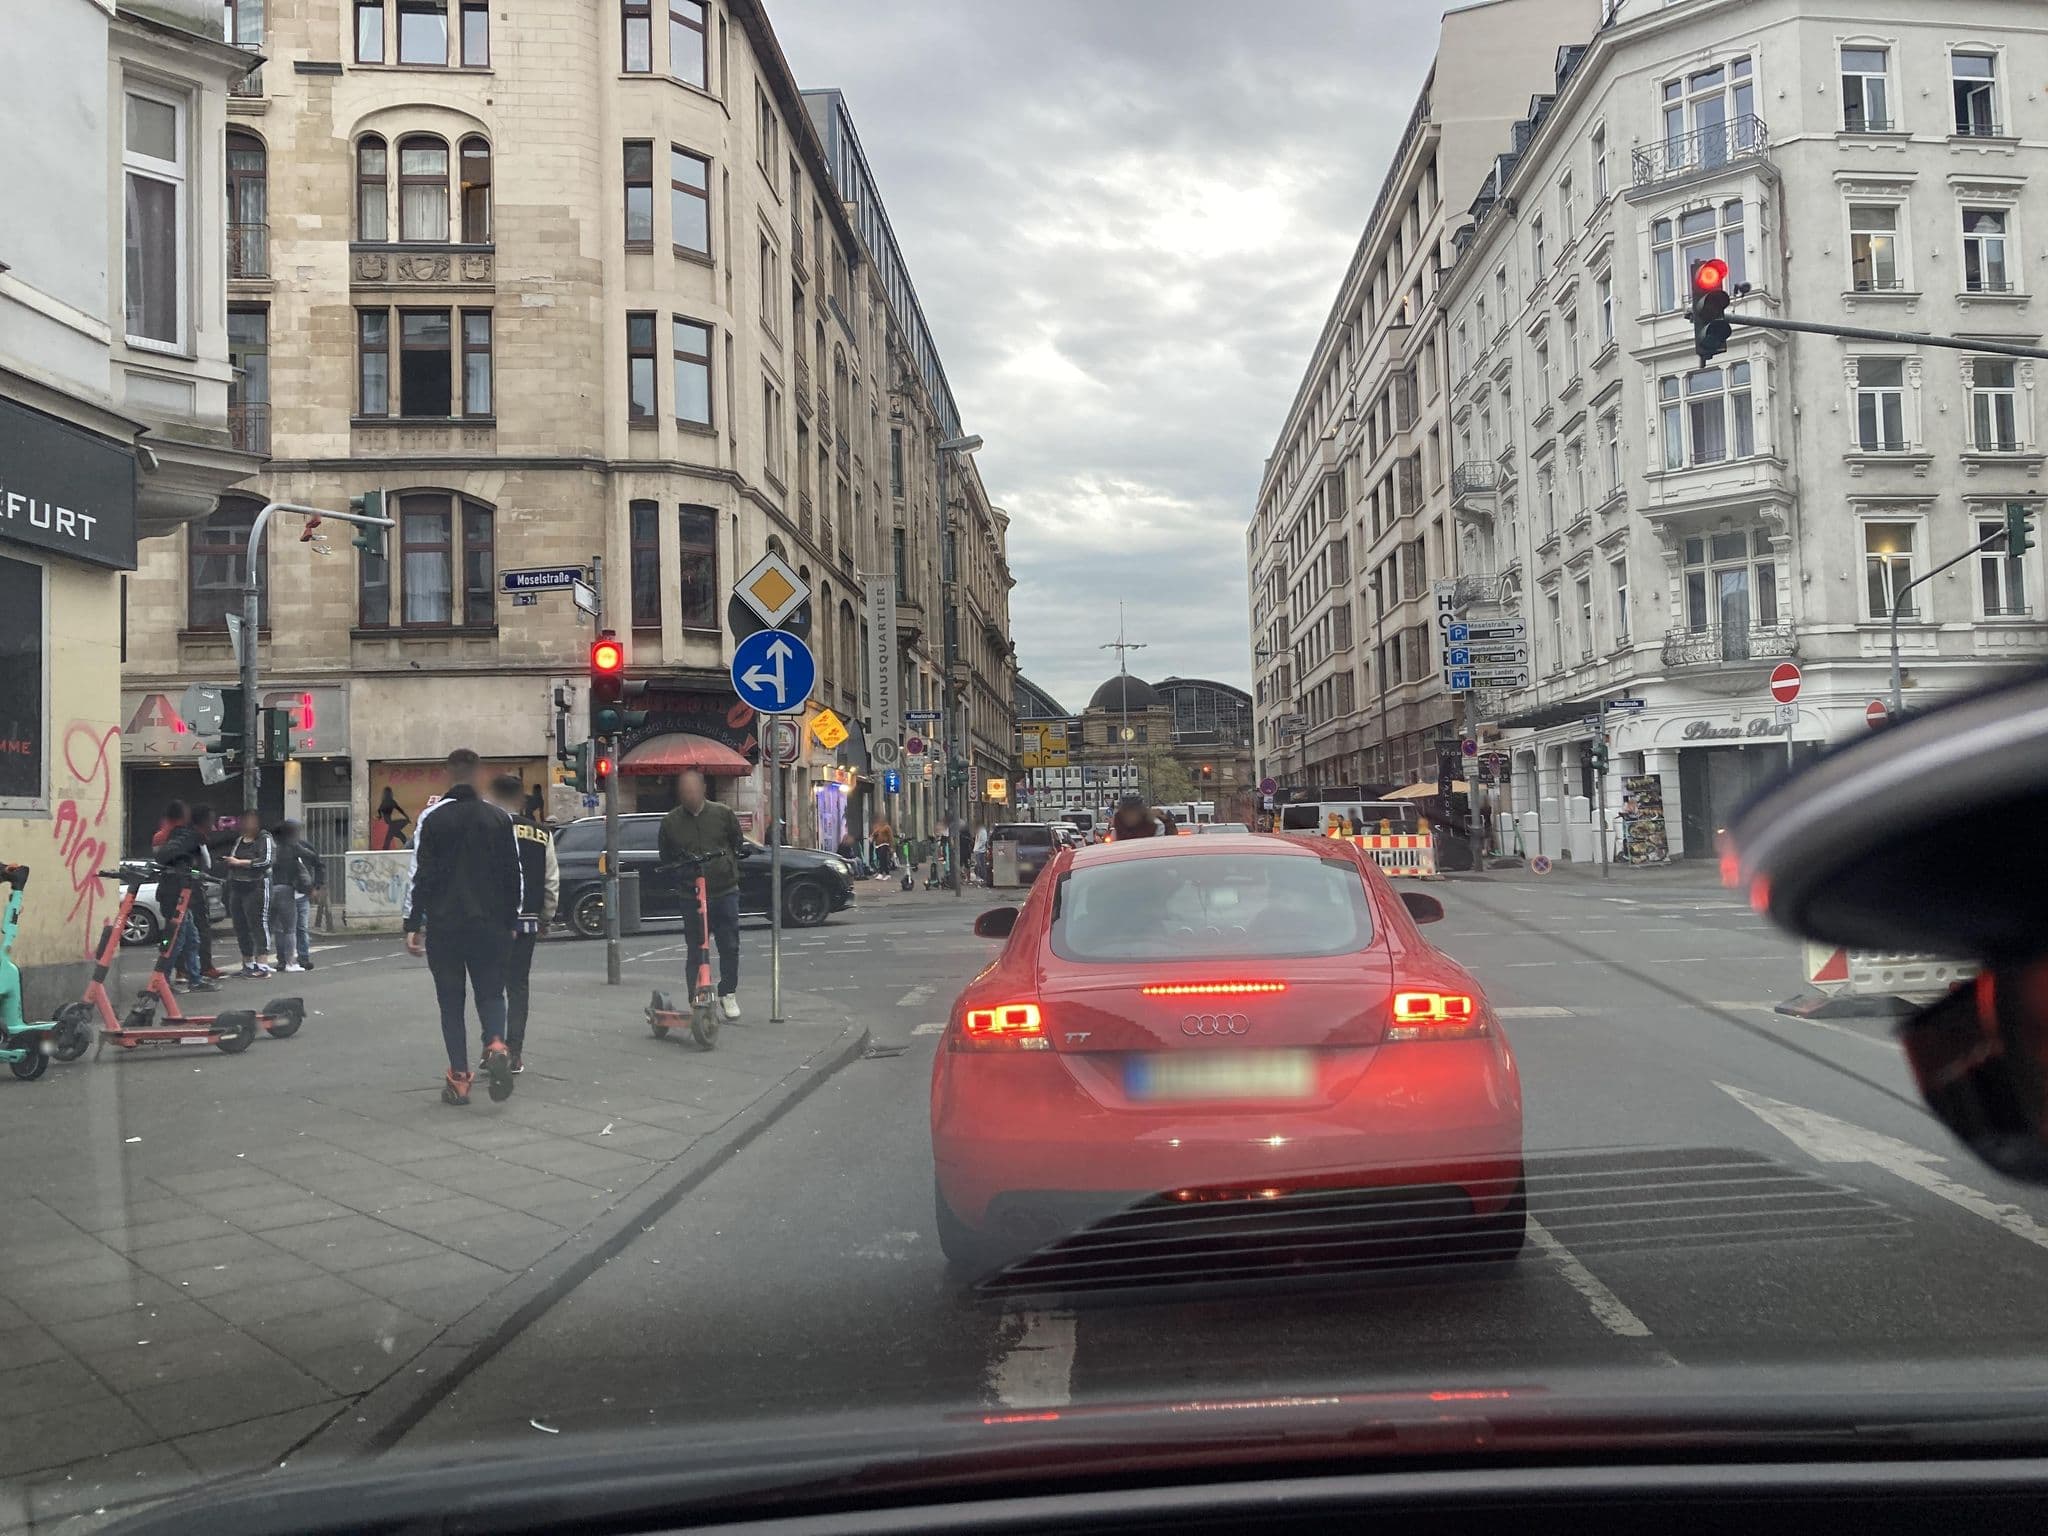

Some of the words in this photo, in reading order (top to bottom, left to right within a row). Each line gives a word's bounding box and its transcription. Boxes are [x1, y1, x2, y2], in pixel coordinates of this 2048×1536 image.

[0, 490, 97, 541] FURT
[517, 572, 570, 586] Moselstraße
[876, 587, 889, 728] TAUNUSQUARTIER
[1681, 720, 1742, 741] Plaza
[1746, 716, 1790, 738] Bar
[969, 767, 977, 801] Canon
[1065, 1032, 1092, 1044] TT
